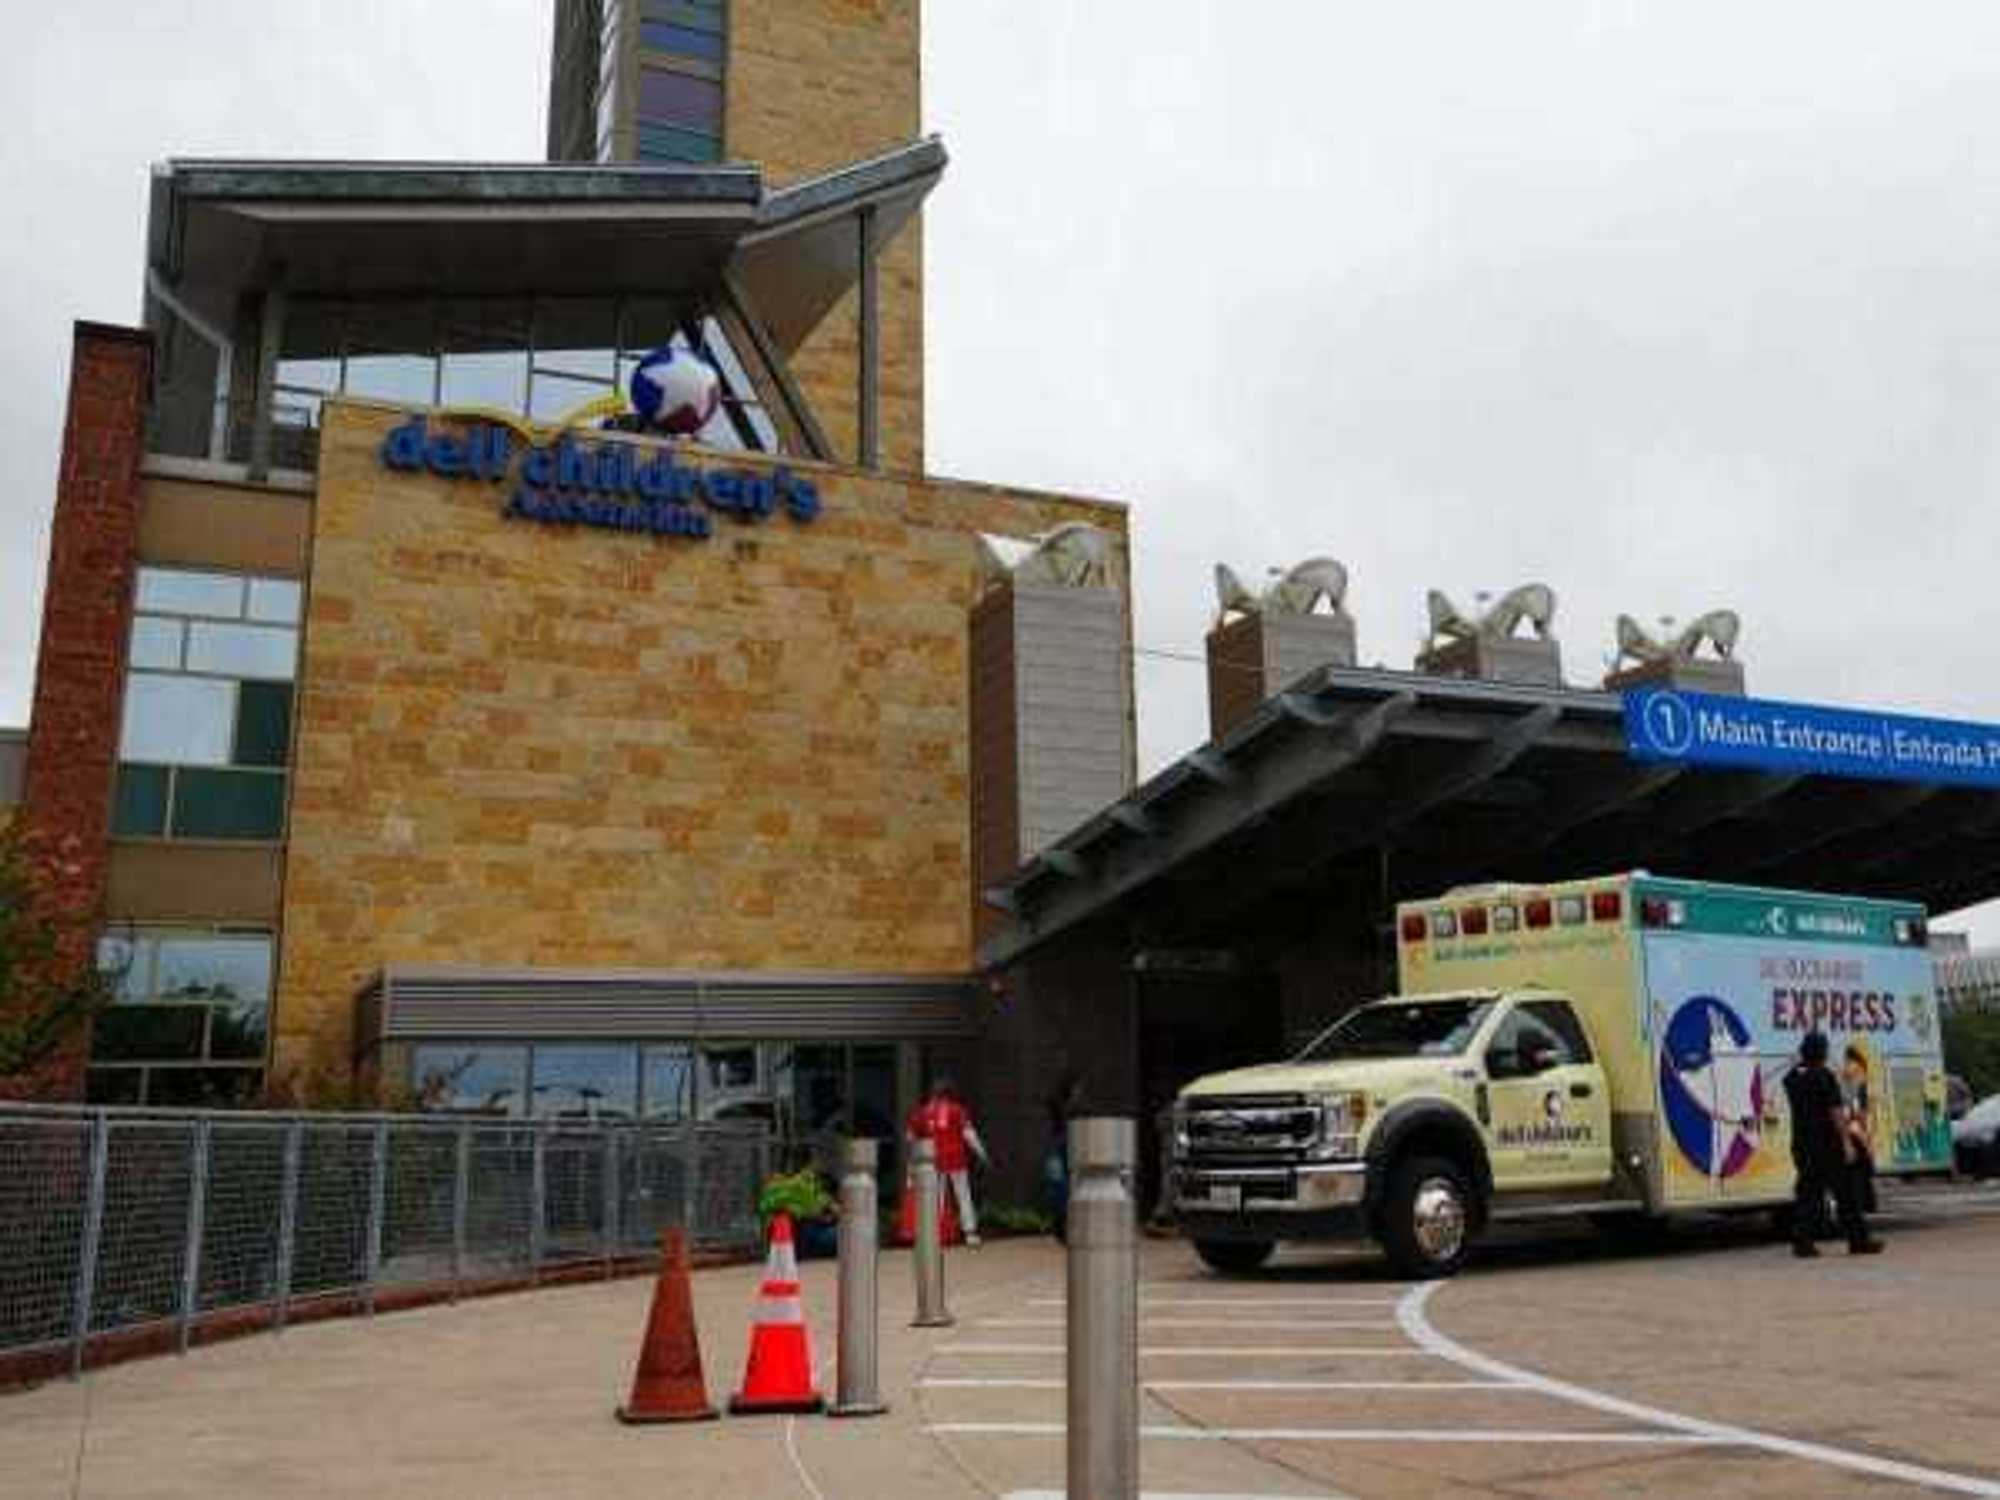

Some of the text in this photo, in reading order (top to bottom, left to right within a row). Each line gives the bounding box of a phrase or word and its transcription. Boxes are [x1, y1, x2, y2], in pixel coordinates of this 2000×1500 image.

[382, 416, 820, 524] dell children's
[1698, 710, 1767, 749] Main
[1773, 720, 1882, 760] Entrance
[1772, 987, 1896, 1033] EXPRESS
